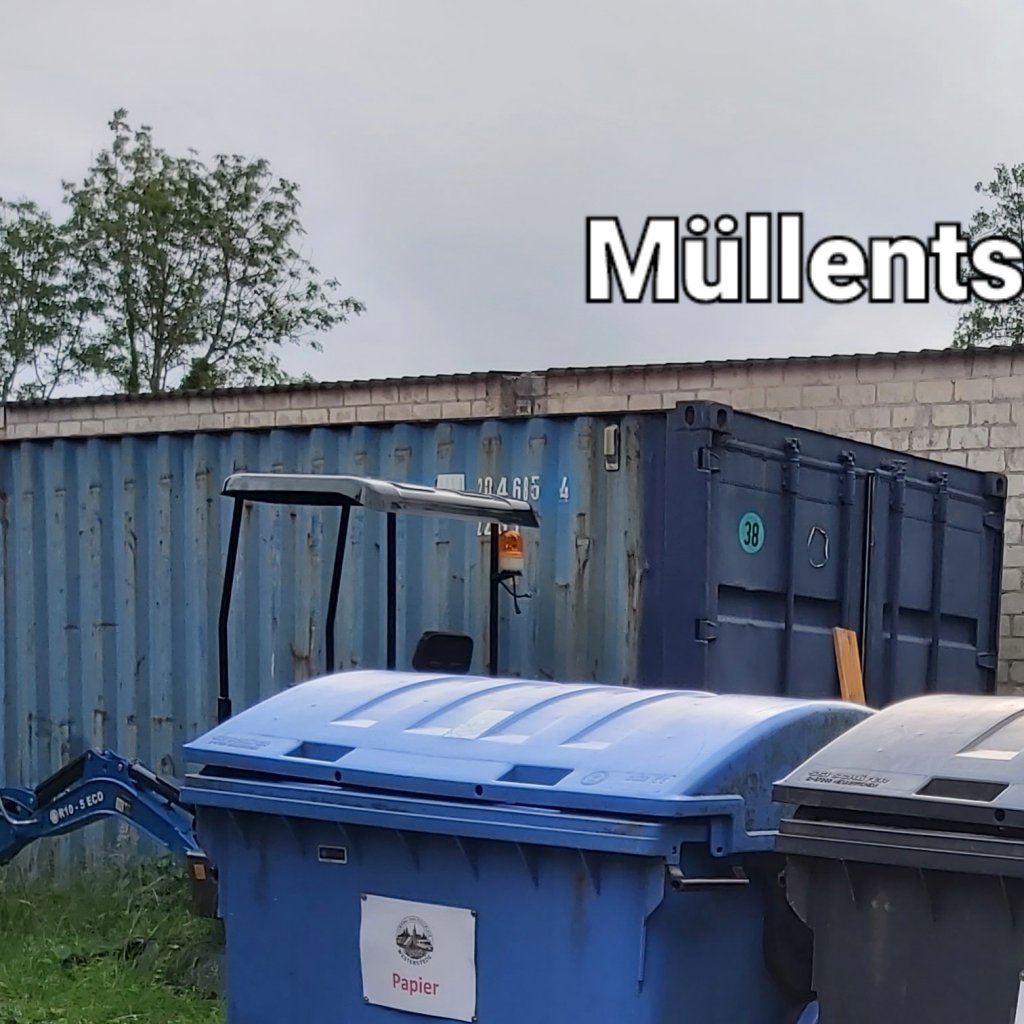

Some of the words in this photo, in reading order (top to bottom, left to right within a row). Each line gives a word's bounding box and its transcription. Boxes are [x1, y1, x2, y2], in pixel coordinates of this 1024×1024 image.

[559, 476, 569, 502] 4
[743, 520, 760, 547] 38
[86, 790, 104, 807] ECO
[392, 972, 440, 996] Papier
